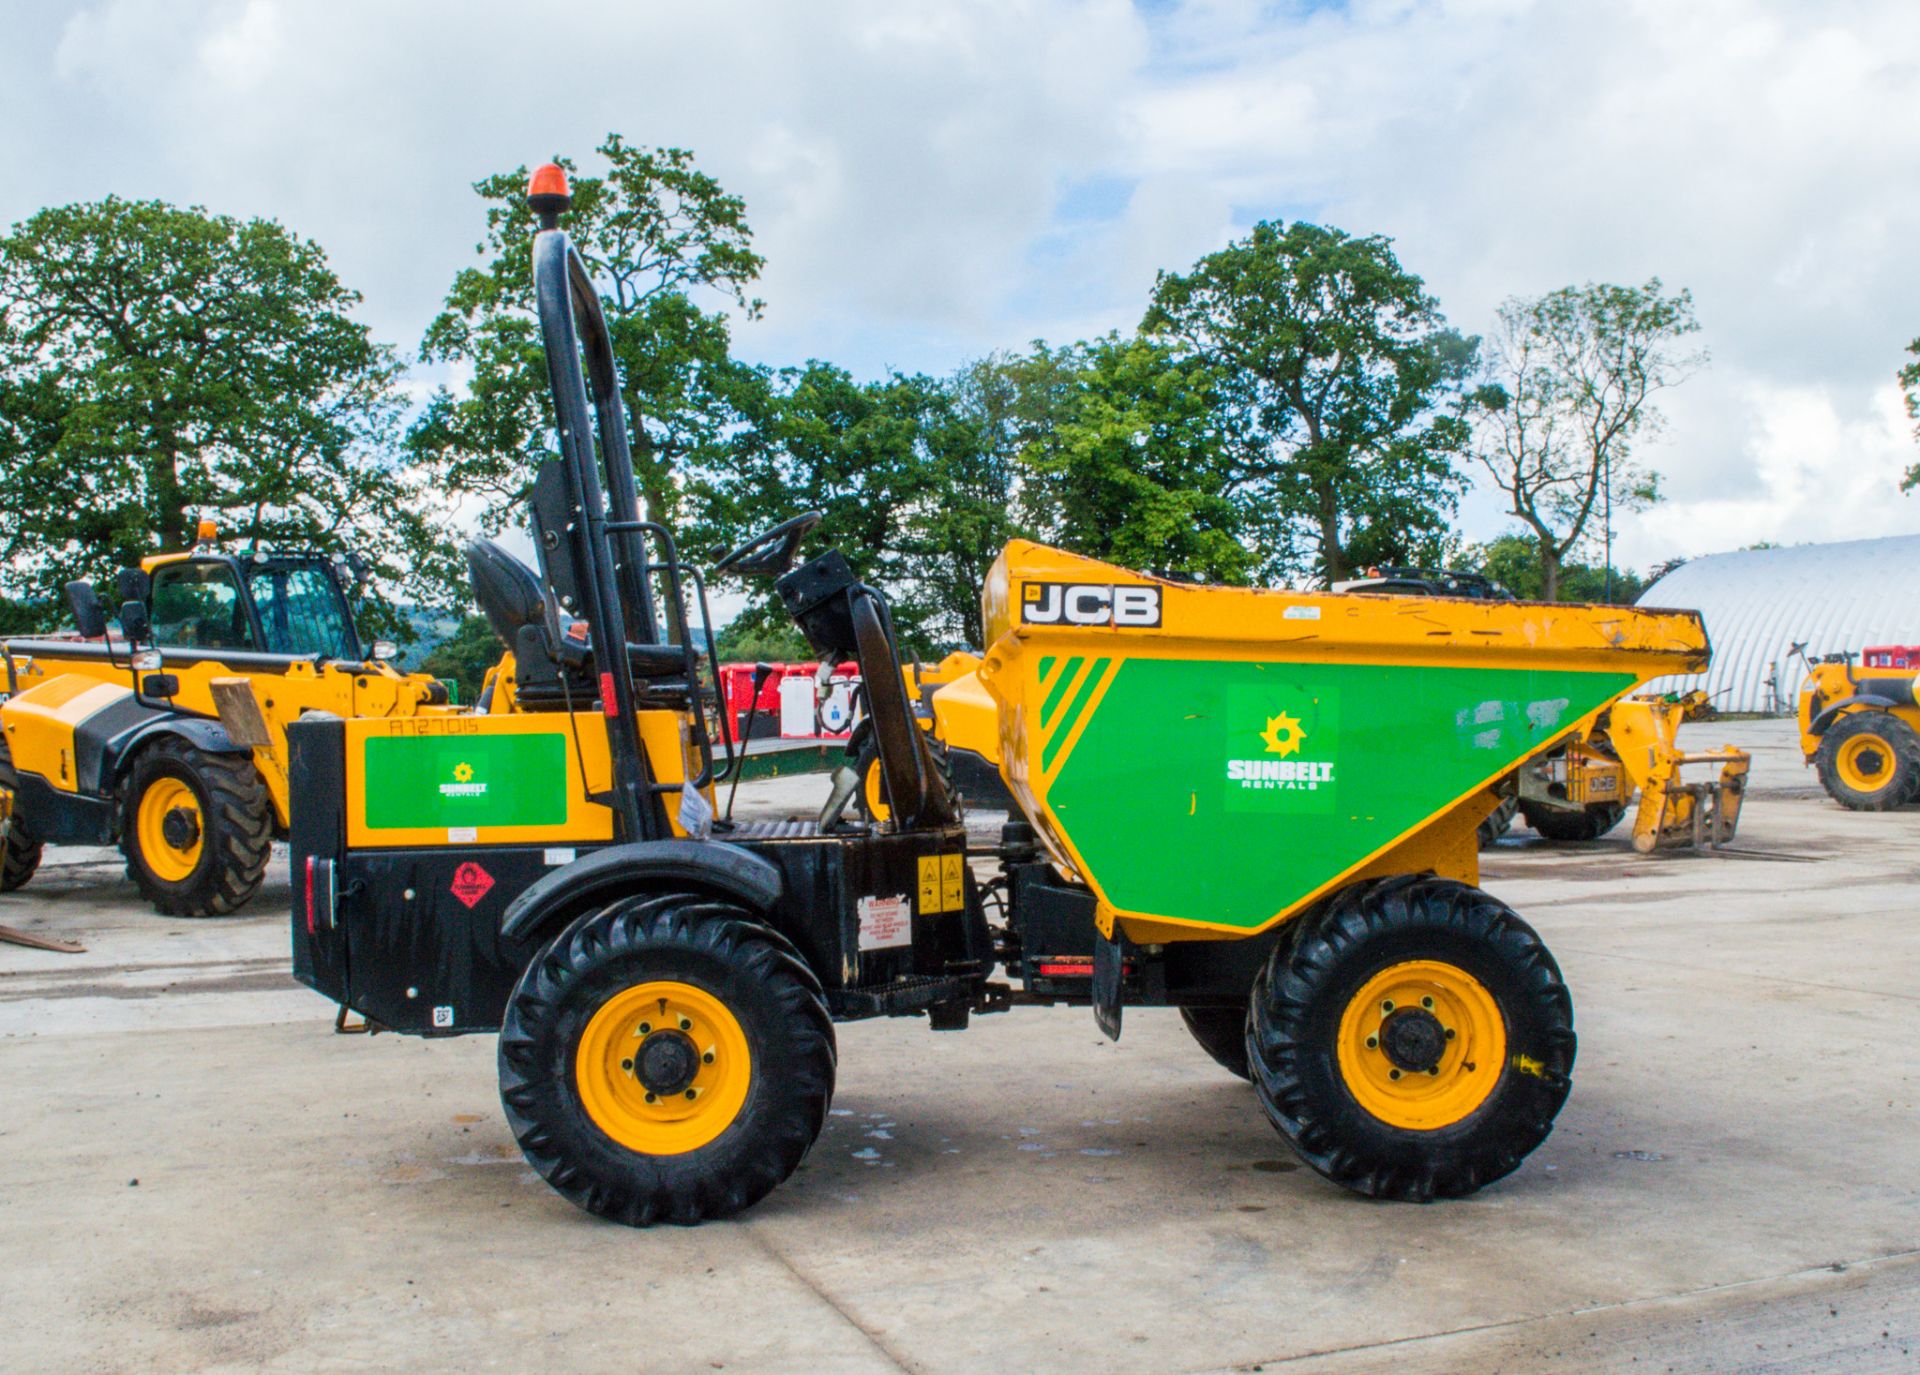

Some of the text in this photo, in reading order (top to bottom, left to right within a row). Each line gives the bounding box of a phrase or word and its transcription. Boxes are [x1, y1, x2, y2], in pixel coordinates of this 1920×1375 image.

[1024, 585, 1159, 624] JCB
[1227, 760, 1334, 781] SUNBELT
[1242, 780, 1317, 790] RENTALS
